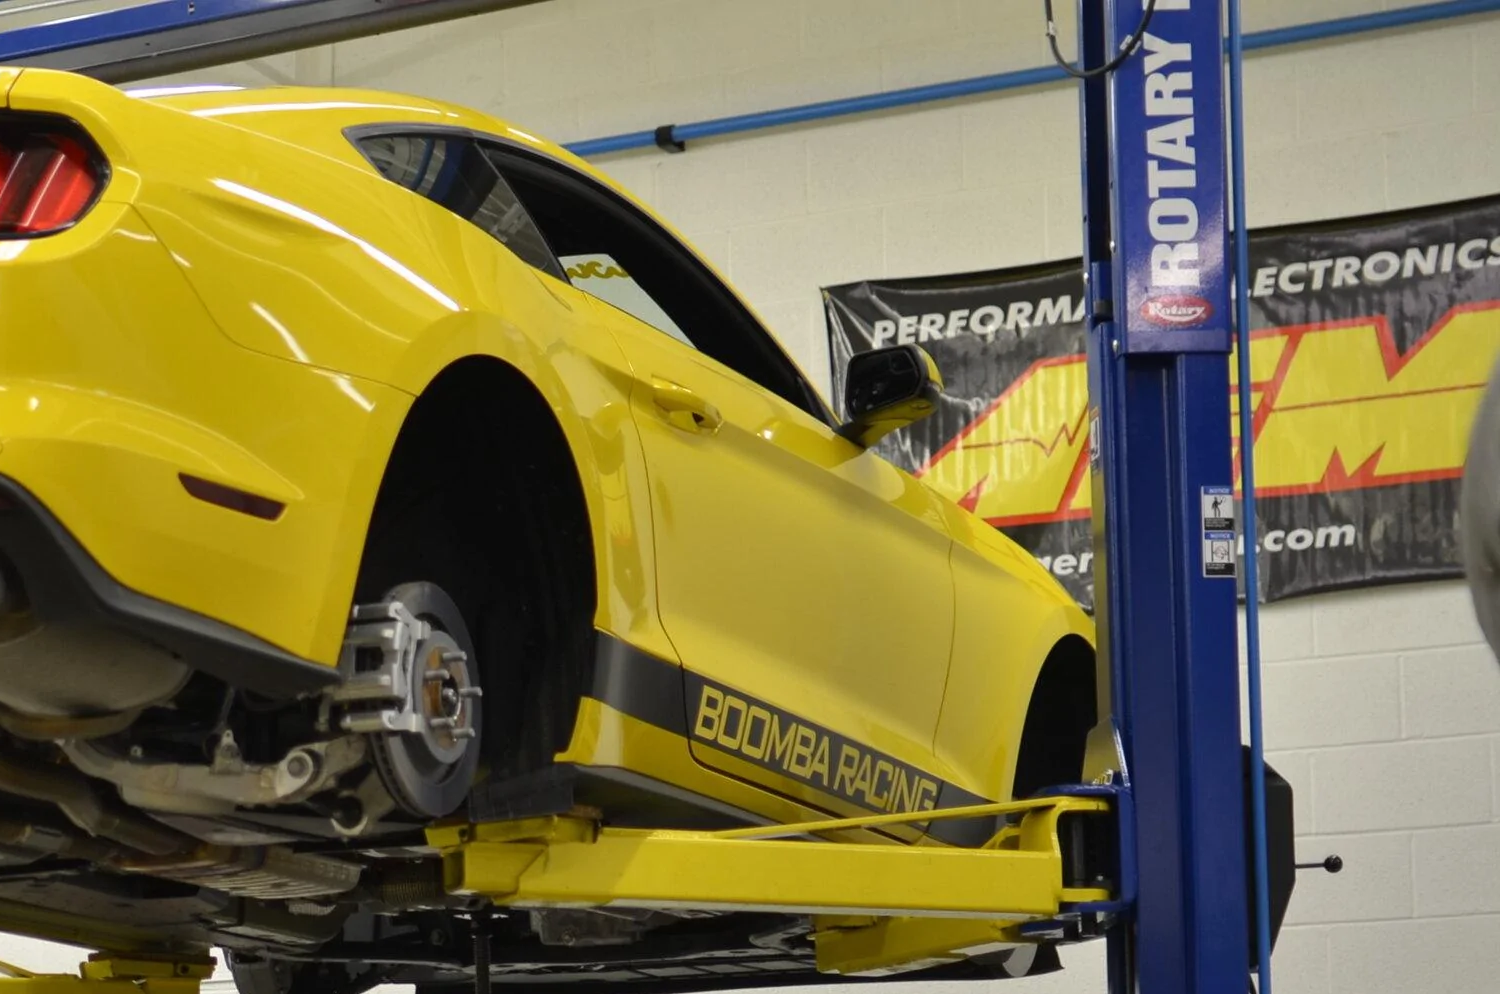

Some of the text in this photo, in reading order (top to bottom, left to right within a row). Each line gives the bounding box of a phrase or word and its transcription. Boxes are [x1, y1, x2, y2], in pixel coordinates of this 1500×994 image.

[1143, 32, 1199, 287] ROTARY
[1148, 301, 1205, 322] Rotary
[695, 685, 937, 814] BOOMBA RACING
